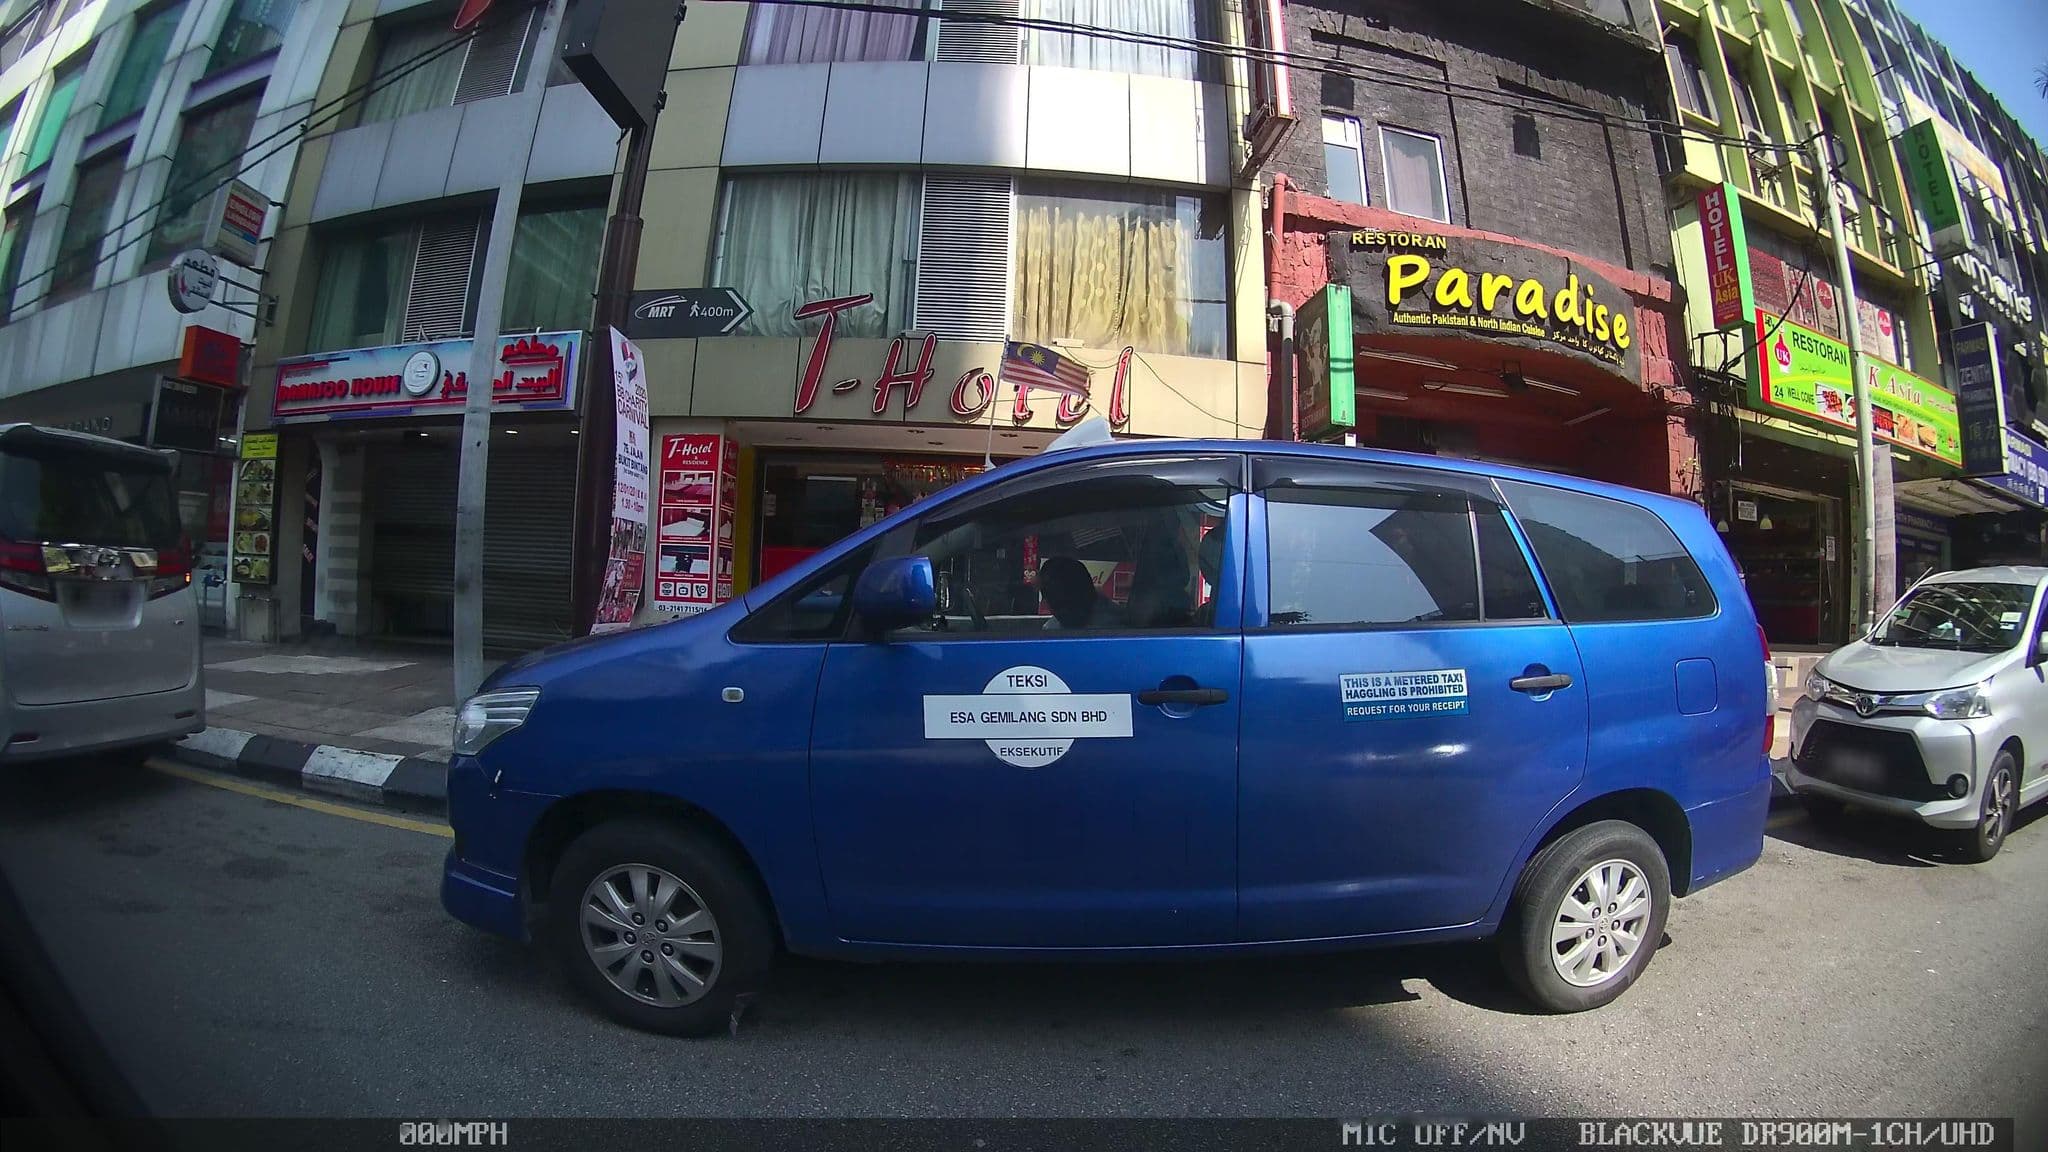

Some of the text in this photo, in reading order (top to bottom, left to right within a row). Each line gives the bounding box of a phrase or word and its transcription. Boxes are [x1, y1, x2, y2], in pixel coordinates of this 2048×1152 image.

[1914, 128, 1944, 216] HOTEL
[1705, 191, 1729, 272] HOTEL
[1352, 232, 1447, 250] RESTORAN
[1712, 268, 1736, 288] UK
[1386, 254, 1631, 349] Paradise
[1715, 284, 1739, 304] Asia
[647, 305, 734, 318] MRT 400m
[1393, 311, 1546, 337] Authentic Pakistani & North Indian Cuisine
[1776, 347, 1789, 363] UK
[1792, 331, 1847, 366] RESTORAN
[1774, 384, 1784, 399] 24
[1886, 376, 1921, 406] Asia
[668, 437, 713, 459] T-Hotel
[1006, 674, 1048, 688] TEKSI
[1344, 672, 1463, 689] THIS IS A METERED TAXI
[1345, 684, 1464, 700] HAGGLING IS PROHIBITED
[950, 710, 1107, 724] ESA GEMILANG SDN BHD
[1347, 700, 1465, 716] REQUEST FOR YOUR RECEIPT
[1000, 746, 1064, 757] EKSEKUTIF
